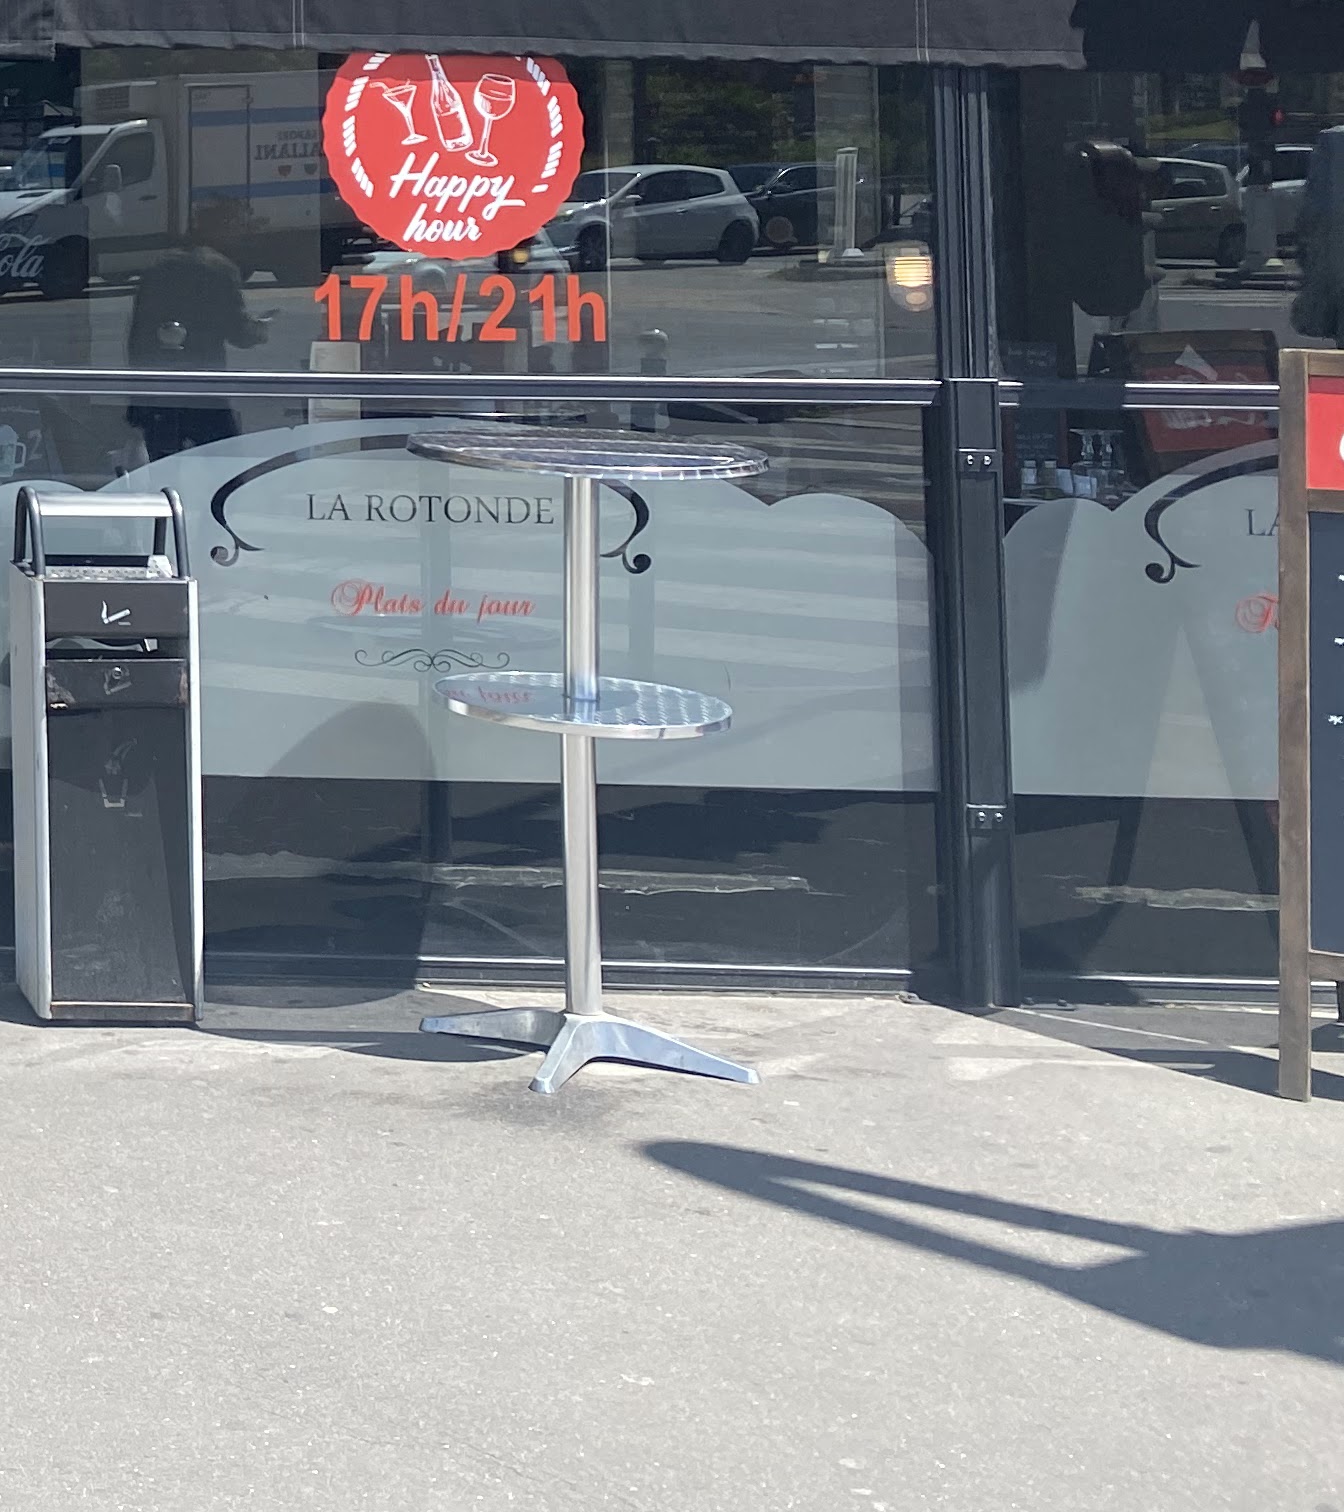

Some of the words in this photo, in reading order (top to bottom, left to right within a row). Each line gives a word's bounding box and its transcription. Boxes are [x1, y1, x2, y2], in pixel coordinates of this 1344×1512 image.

[388, 152, 527, 221] Happy
[402, 211, 484, 244] hour
[312, 273, 609, 343] 17h/21h
[306, 493, 353, 521] LA
[365, 494, 555, 525] ROTONDE
[330, 577, 424, 617] Plats
[433, 588, 471, 616] du
[476, 593, 535, 624] jour
